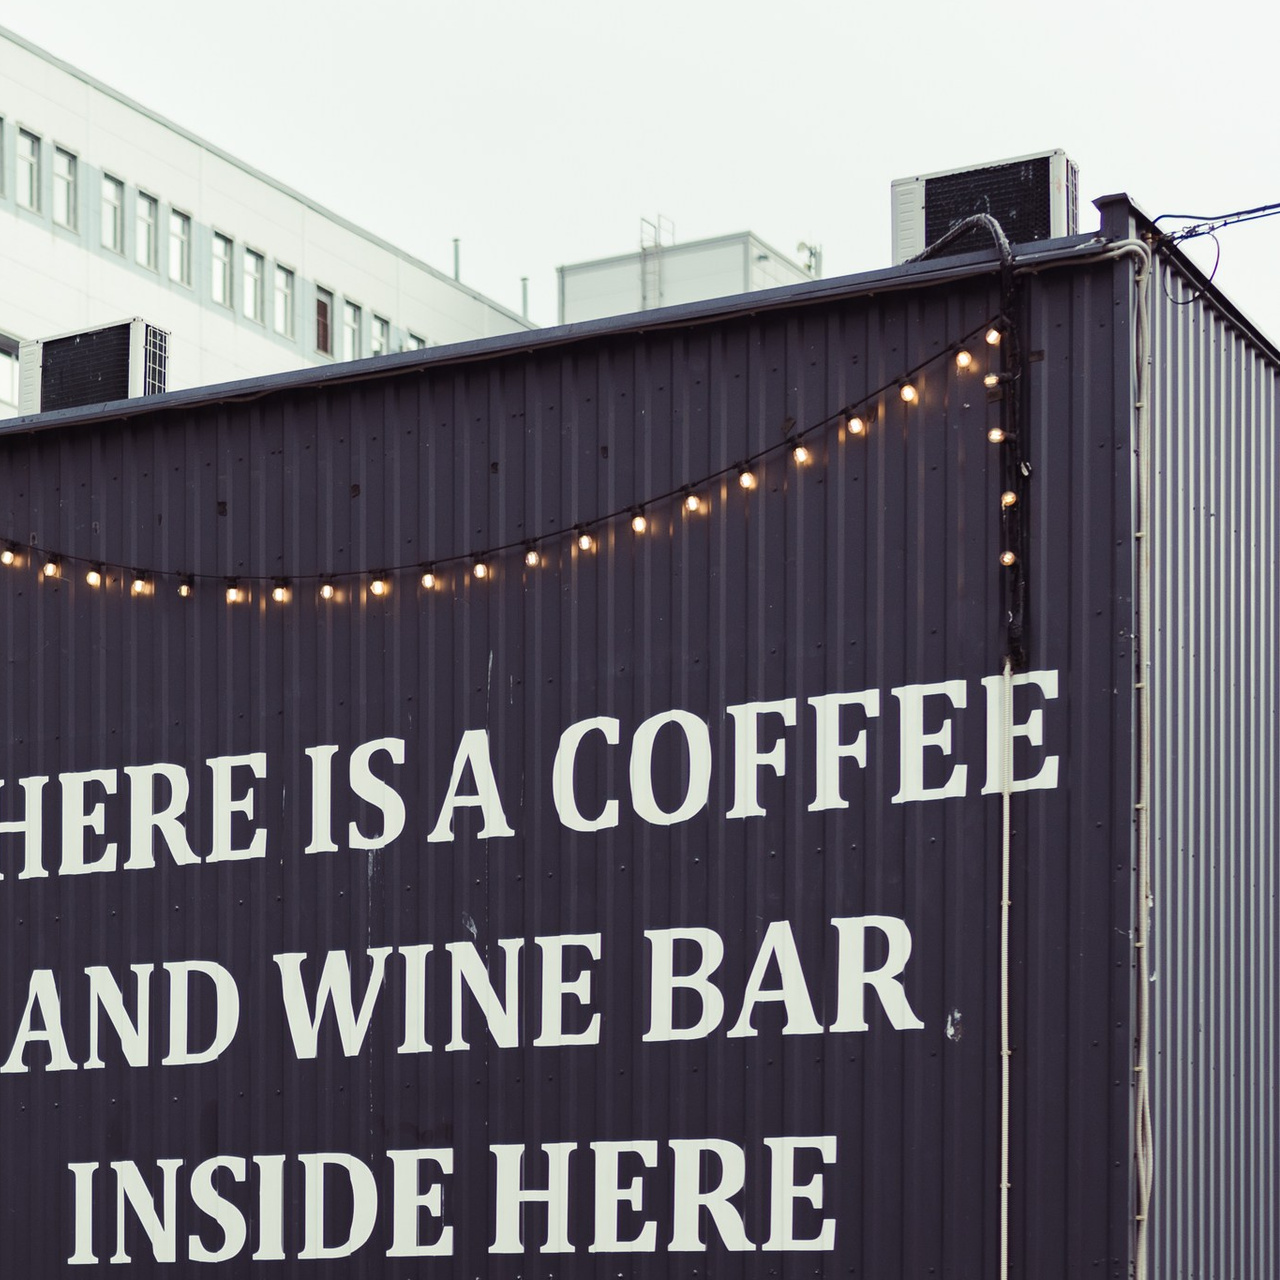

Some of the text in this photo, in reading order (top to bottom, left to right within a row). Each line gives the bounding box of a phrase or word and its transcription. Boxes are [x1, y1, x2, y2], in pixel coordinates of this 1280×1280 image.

[305, 738, 405, 855] IS
[427, 729, 515, 843] A
[553, 668, 1060, 832] COFFEE
[0, 915, 924, 1073] AND WINE BAR
[68, 1136, 836, 1264] INSIDE HERE
